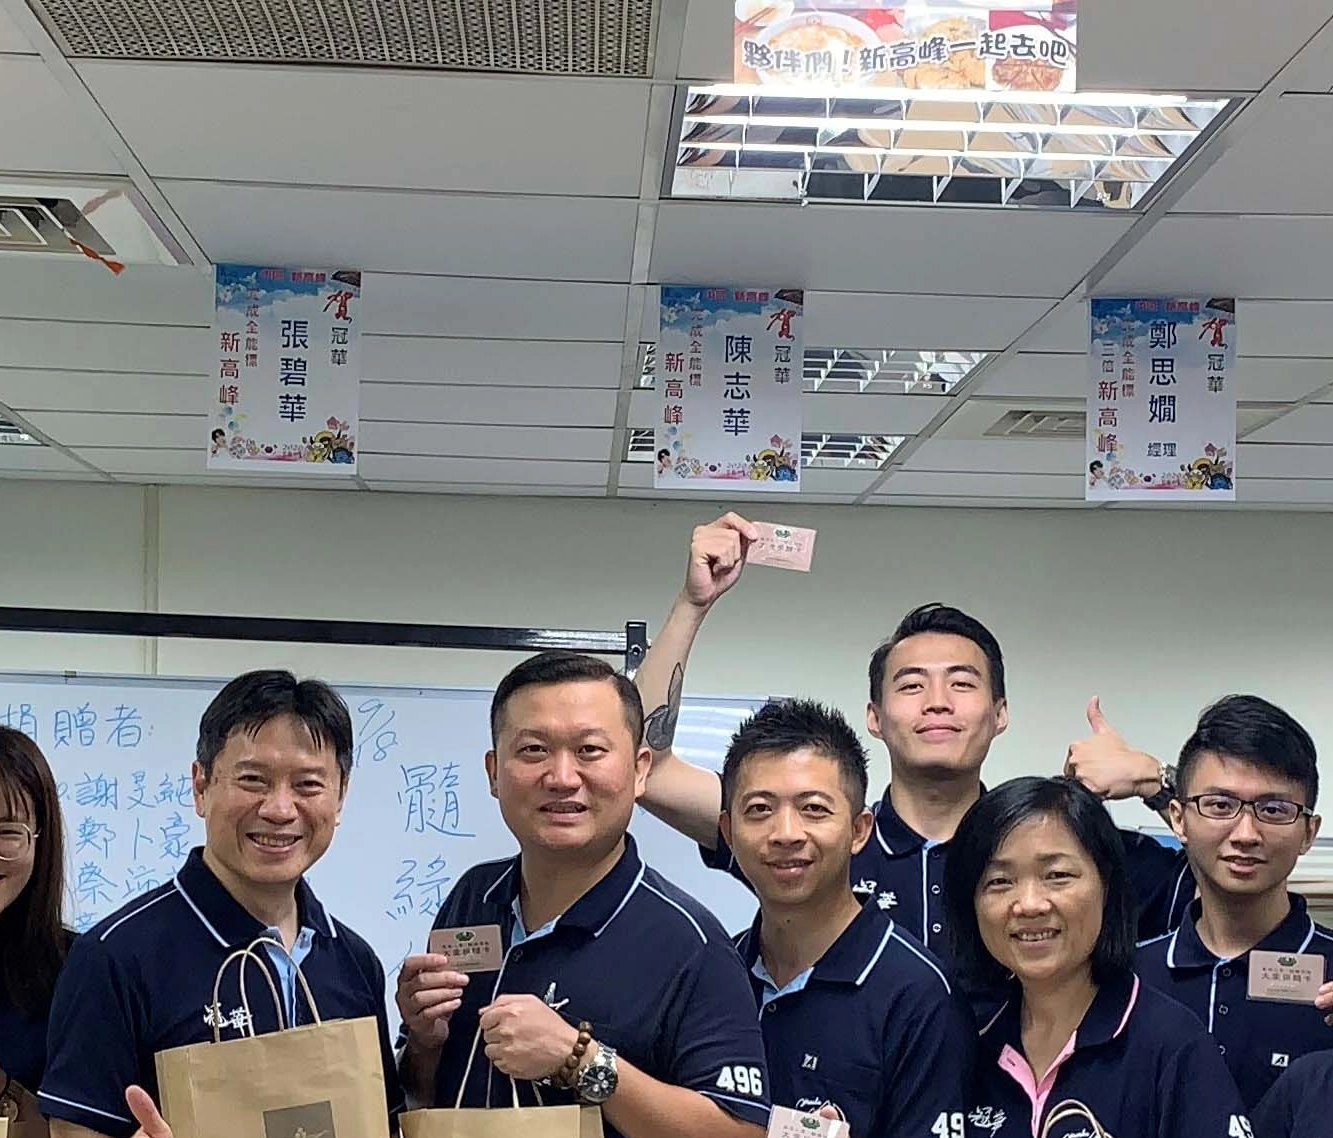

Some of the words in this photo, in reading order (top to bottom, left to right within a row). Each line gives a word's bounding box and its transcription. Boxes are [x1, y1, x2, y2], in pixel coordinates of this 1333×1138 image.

[322, 290, 354, 324] 賀
[766, 308, 797, 342] 賀
[331, 327, 349, 366] 冠華
[1198, 317, 1229, 350] 賀
[219, 331, 240, 405] 新高峰
[279, 319, 309, 422] 張碧華
[774, 345, 792, 385] 冠華
[1207, 353, 1225, 393] 冠華
[663, 352, 684, 425] 新高峰
[723, 335, 753, 437] 陳志華
[716, 1065, 763, 1097] 496
